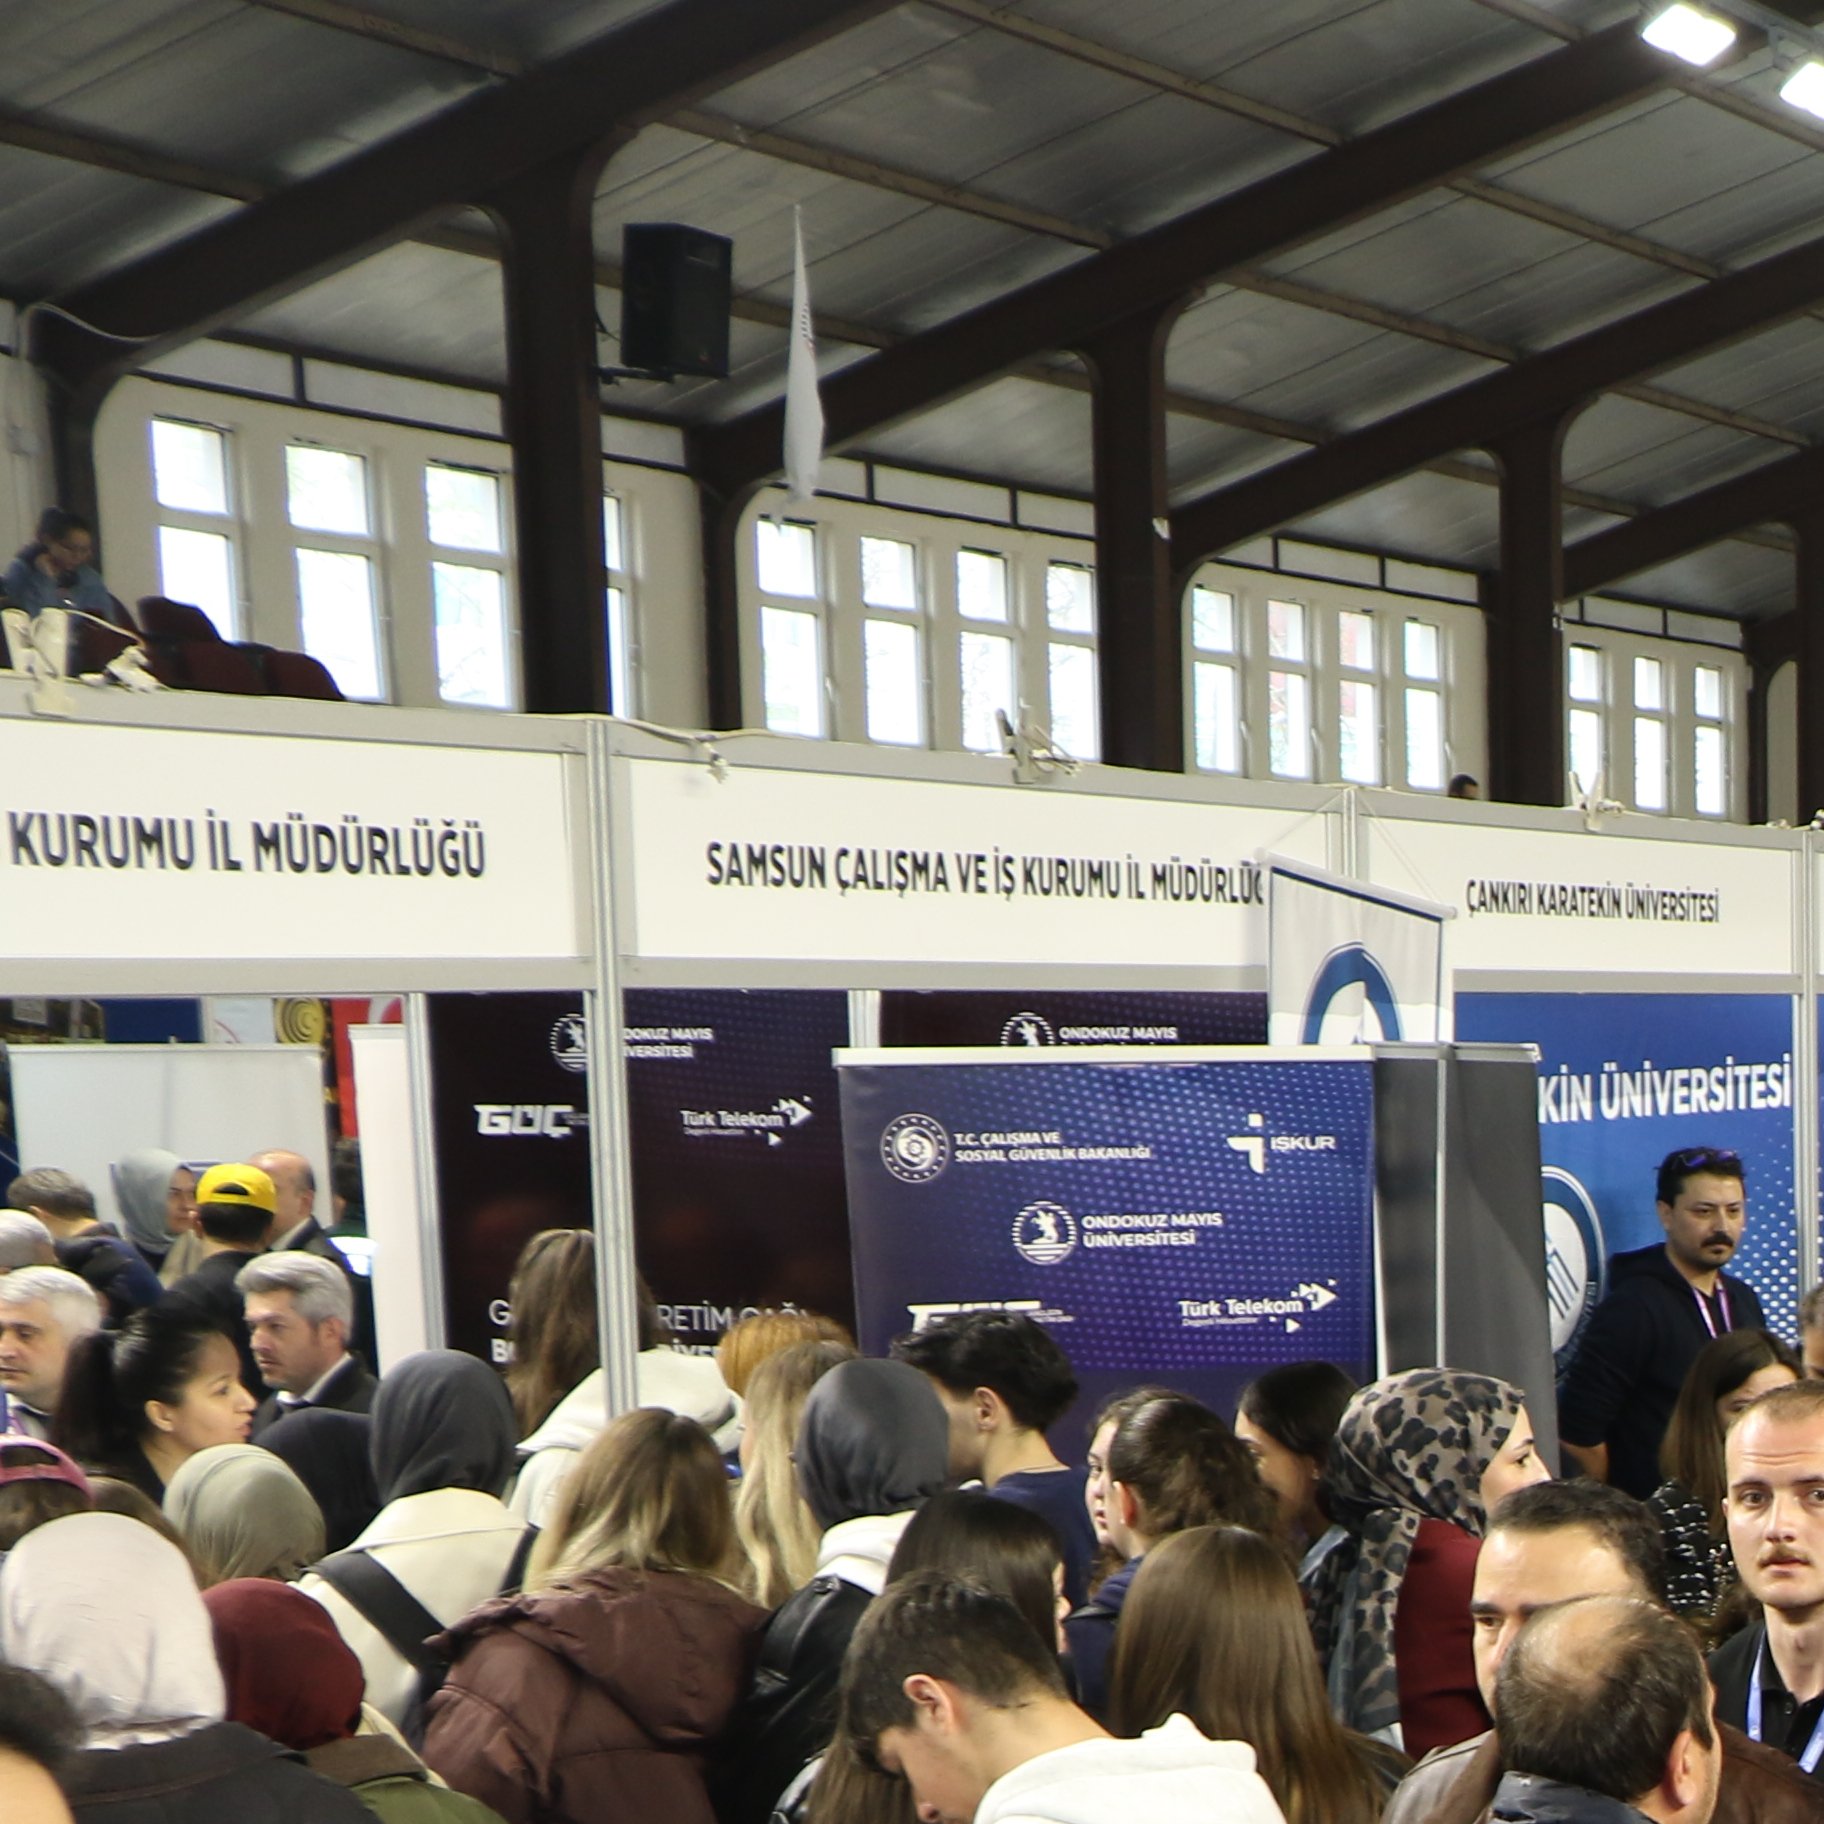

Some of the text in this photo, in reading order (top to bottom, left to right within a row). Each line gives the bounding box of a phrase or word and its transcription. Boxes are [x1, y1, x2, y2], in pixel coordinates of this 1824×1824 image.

[6, 808, 487, 878] KURUMU İL MÜDÜRLÜĞÜ
[706, 841, 1264, 905] SAMSUN ÇALIŞMA VE İŞ KURUMU İL MÜDÜRLÜ
[1466, 879, 1719, 923] ÇANKIRI KARATEKİN ÜNİVERSİTESİ
[623, 1027, 714, 1042] DOKUZ MAYIS
[1059, 1026, 1178, 1041] ONDOKUZ MAYIS
[623, 1043, 694, 1059] İVERSİTESİ
[1538, 1053, 1791, 1124] KİN ÜNİVERSİTESİ
[680, 1110, 785, 1128] Türk Telekom
[954, 1131, 1060, 1149] T.C. ÇALIŞMA VE
[955, 1144, 1151, 1162] SOSYAL GÜVENLİK BAKANLIĞI
[1082, 1212, 1222, 1230] ONDOKUZ MAYIS
[1083, 1229, 1196, 1248] ÜNİVERSİTESİ
[657, 1300, 732, 1332] RETİM
[1178, 1298, 1304, 1317] Türk Telekom
